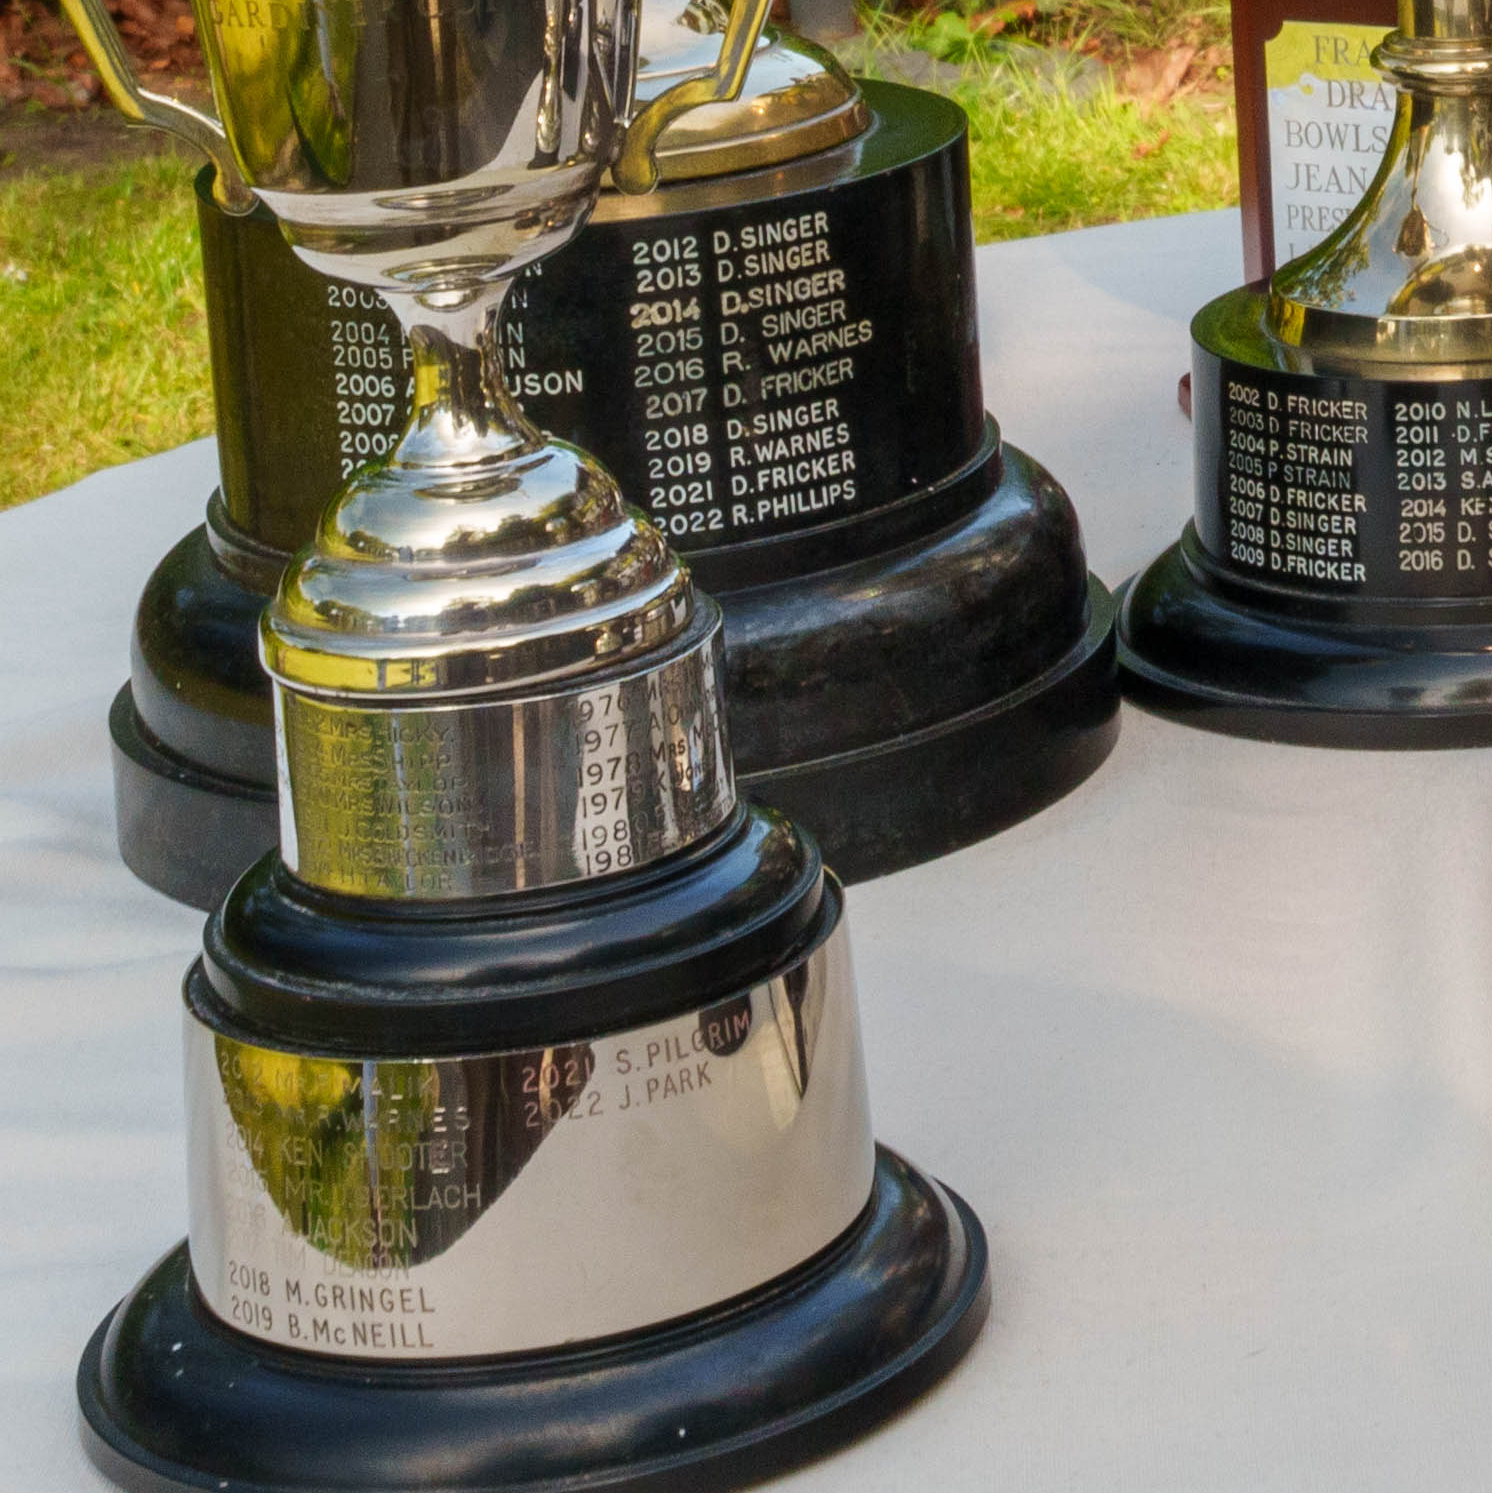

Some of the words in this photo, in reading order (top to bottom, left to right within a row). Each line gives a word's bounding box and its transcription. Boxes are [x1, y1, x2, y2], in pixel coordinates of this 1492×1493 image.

[1313, 34, 1373, 67] FRA
[1325, 79, 1394, 112] DRA
[1284, 119, 1388, 156] BOWLS
[1286, 161, 1369, 196] JEAN
[1286, 203, 1350, 234] PRES
[632, 236, 699, 265] 2012
[636, 263, 702, 293] 2013
[630, 296, 702, 329] 2014
[330, 320, 390, 345] 2004
[636, 326, 703, 358] 2015
[761, 299, 846, 338] SINGER
[332, 345, 393, 370] 2005
[634, 358, 705, 388] 2016
[767, 320, 873, 365] WARNES
[335, 373, 396, 398] 2006
[645, 388, 708, 420] 2017
[761, 358, 854, 401] FRICKER
[336, 400, 396, 426] 2007
[1228, 381, 1260, 408] 2002
[1287, 394, 1369, 421] FRICKER
[1395, 402, 1446, 422] 2010
[645, 423, 709, 451] 2018
[1229, 407, 1265, 432] 2003
[1288, 419, 1369, 445] FRICKER
[1396, 425, 1439, 445] 2011
[1229, 429, 1266, 456] 2004
[648, 451, 712, 479] 2019
[1228, 450, 1264, 478] 2005
[1283, 465, 1351, 490] STRAIN
[1397, 448, 1447, 468] 2012
[650, 480, 713, 509] 2021
[1229, 473, 1266, 500] 2006
[1397, 472, 1448, 492] 2013
[652, 508, 724, 537] 2022
[1229, 495, 1264, 522] 2007
[1400, 498, 1447, 518] 2014
[1230, 518, 1265, 545] 2008
[1399, 521, 1446, 544] 2015
[1230, 540, 1265, 568] 2009
[1399, 549, 1444, 572] 2016
[577, 751, 641, 788] 1978
[522, 1057, 592, 1093] 2021
[524, 1089, 605, 1129] 2022
[279, 1136, 323, 1168] KEN
[228, 1258, 271, 1296] 2018
[231, 1294, 273, 1331] 2019
